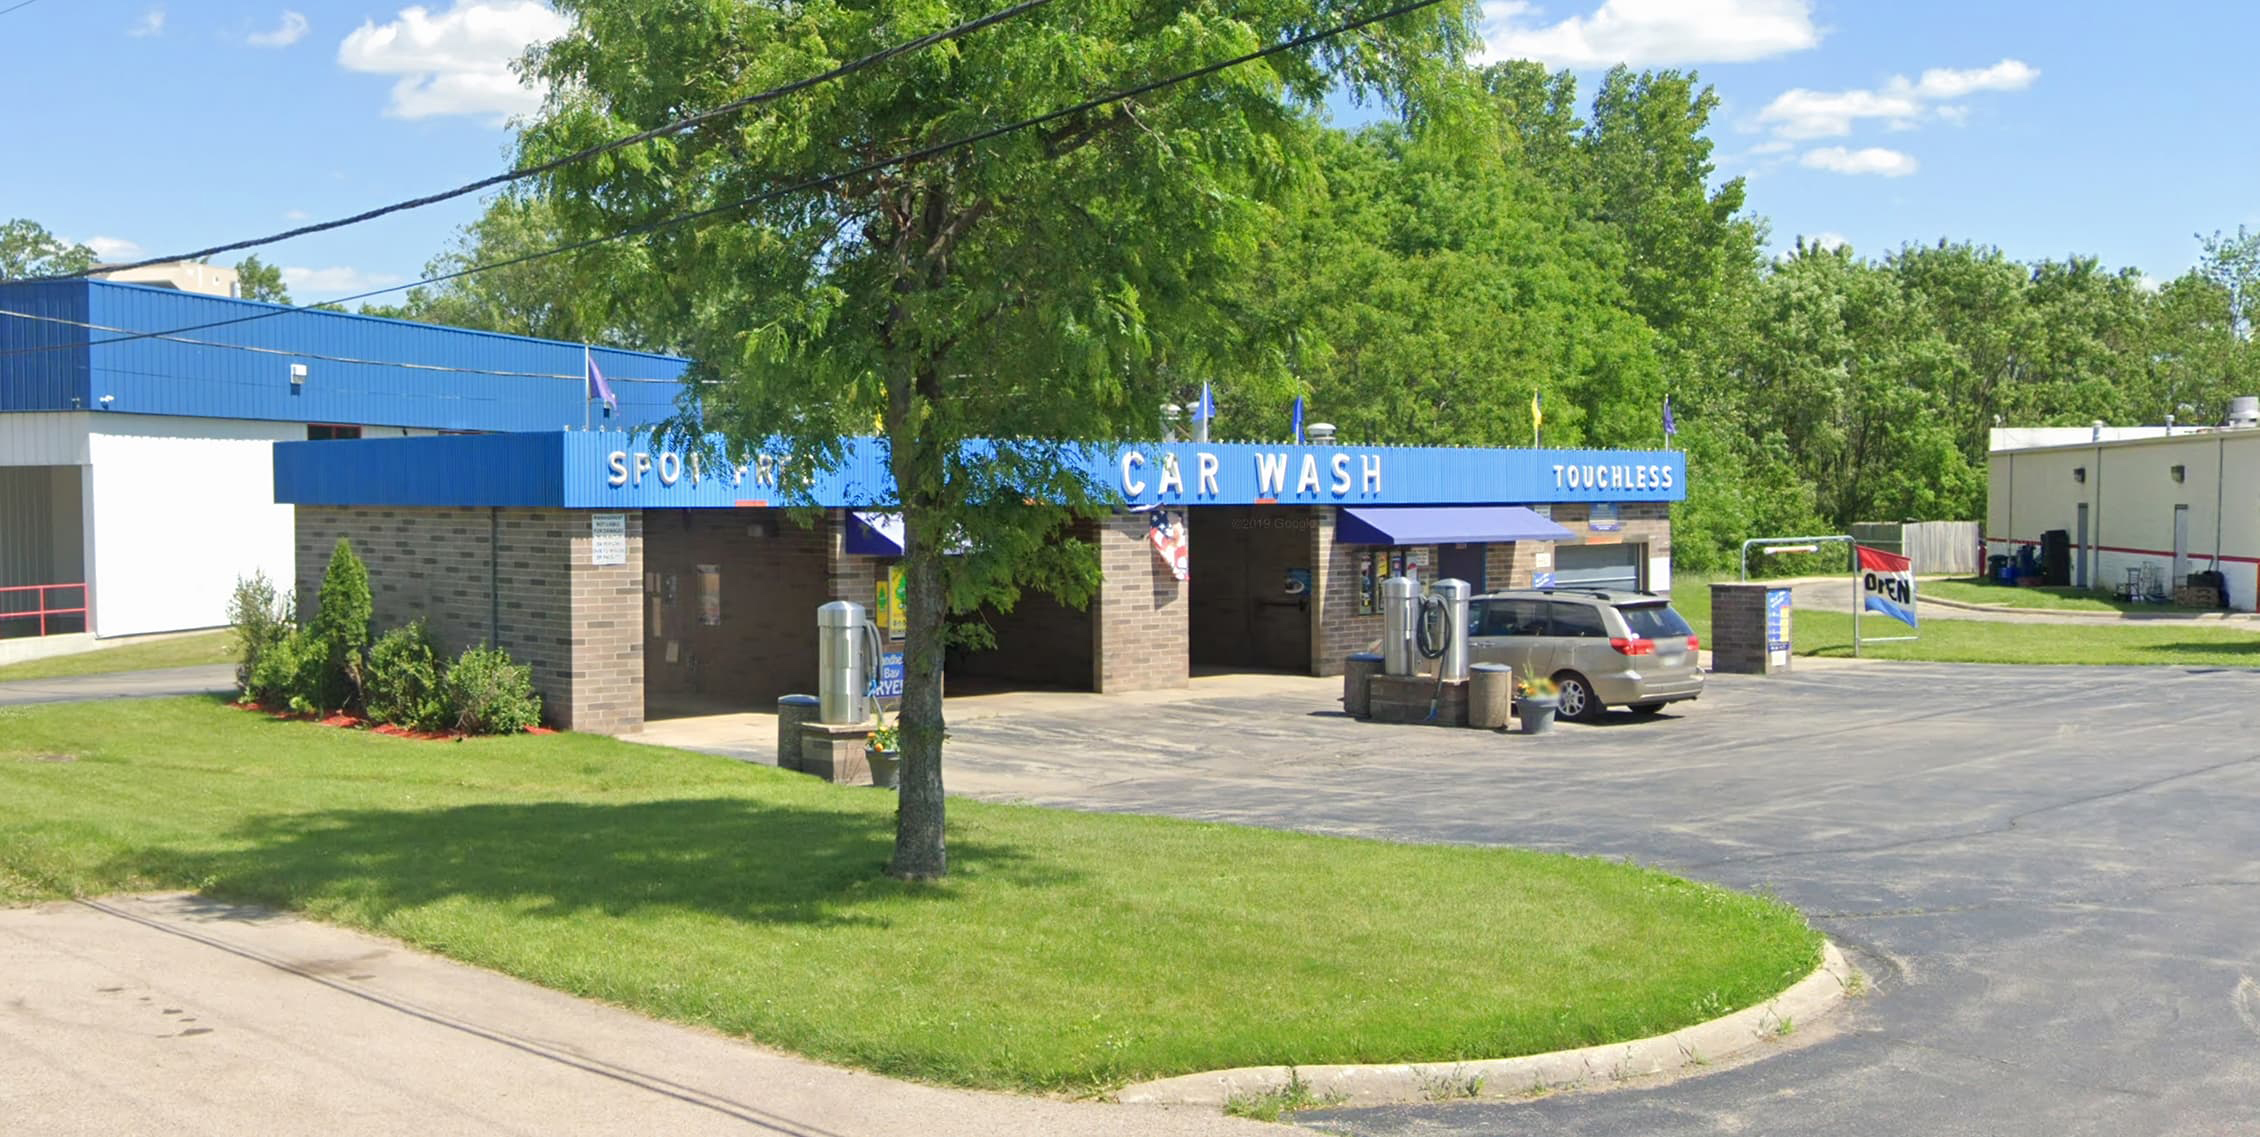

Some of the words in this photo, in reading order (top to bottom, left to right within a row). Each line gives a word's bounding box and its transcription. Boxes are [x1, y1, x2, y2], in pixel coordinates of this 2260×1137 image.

[1121, 451, 1219, 497] CAR
[1255, 453, 1381, 495] WASH
[1553, 465, 1673, 488] TOUCHLESS
[1865, 573, 1910, 604] OPEN
[875, 680, 903, 695] RYE
